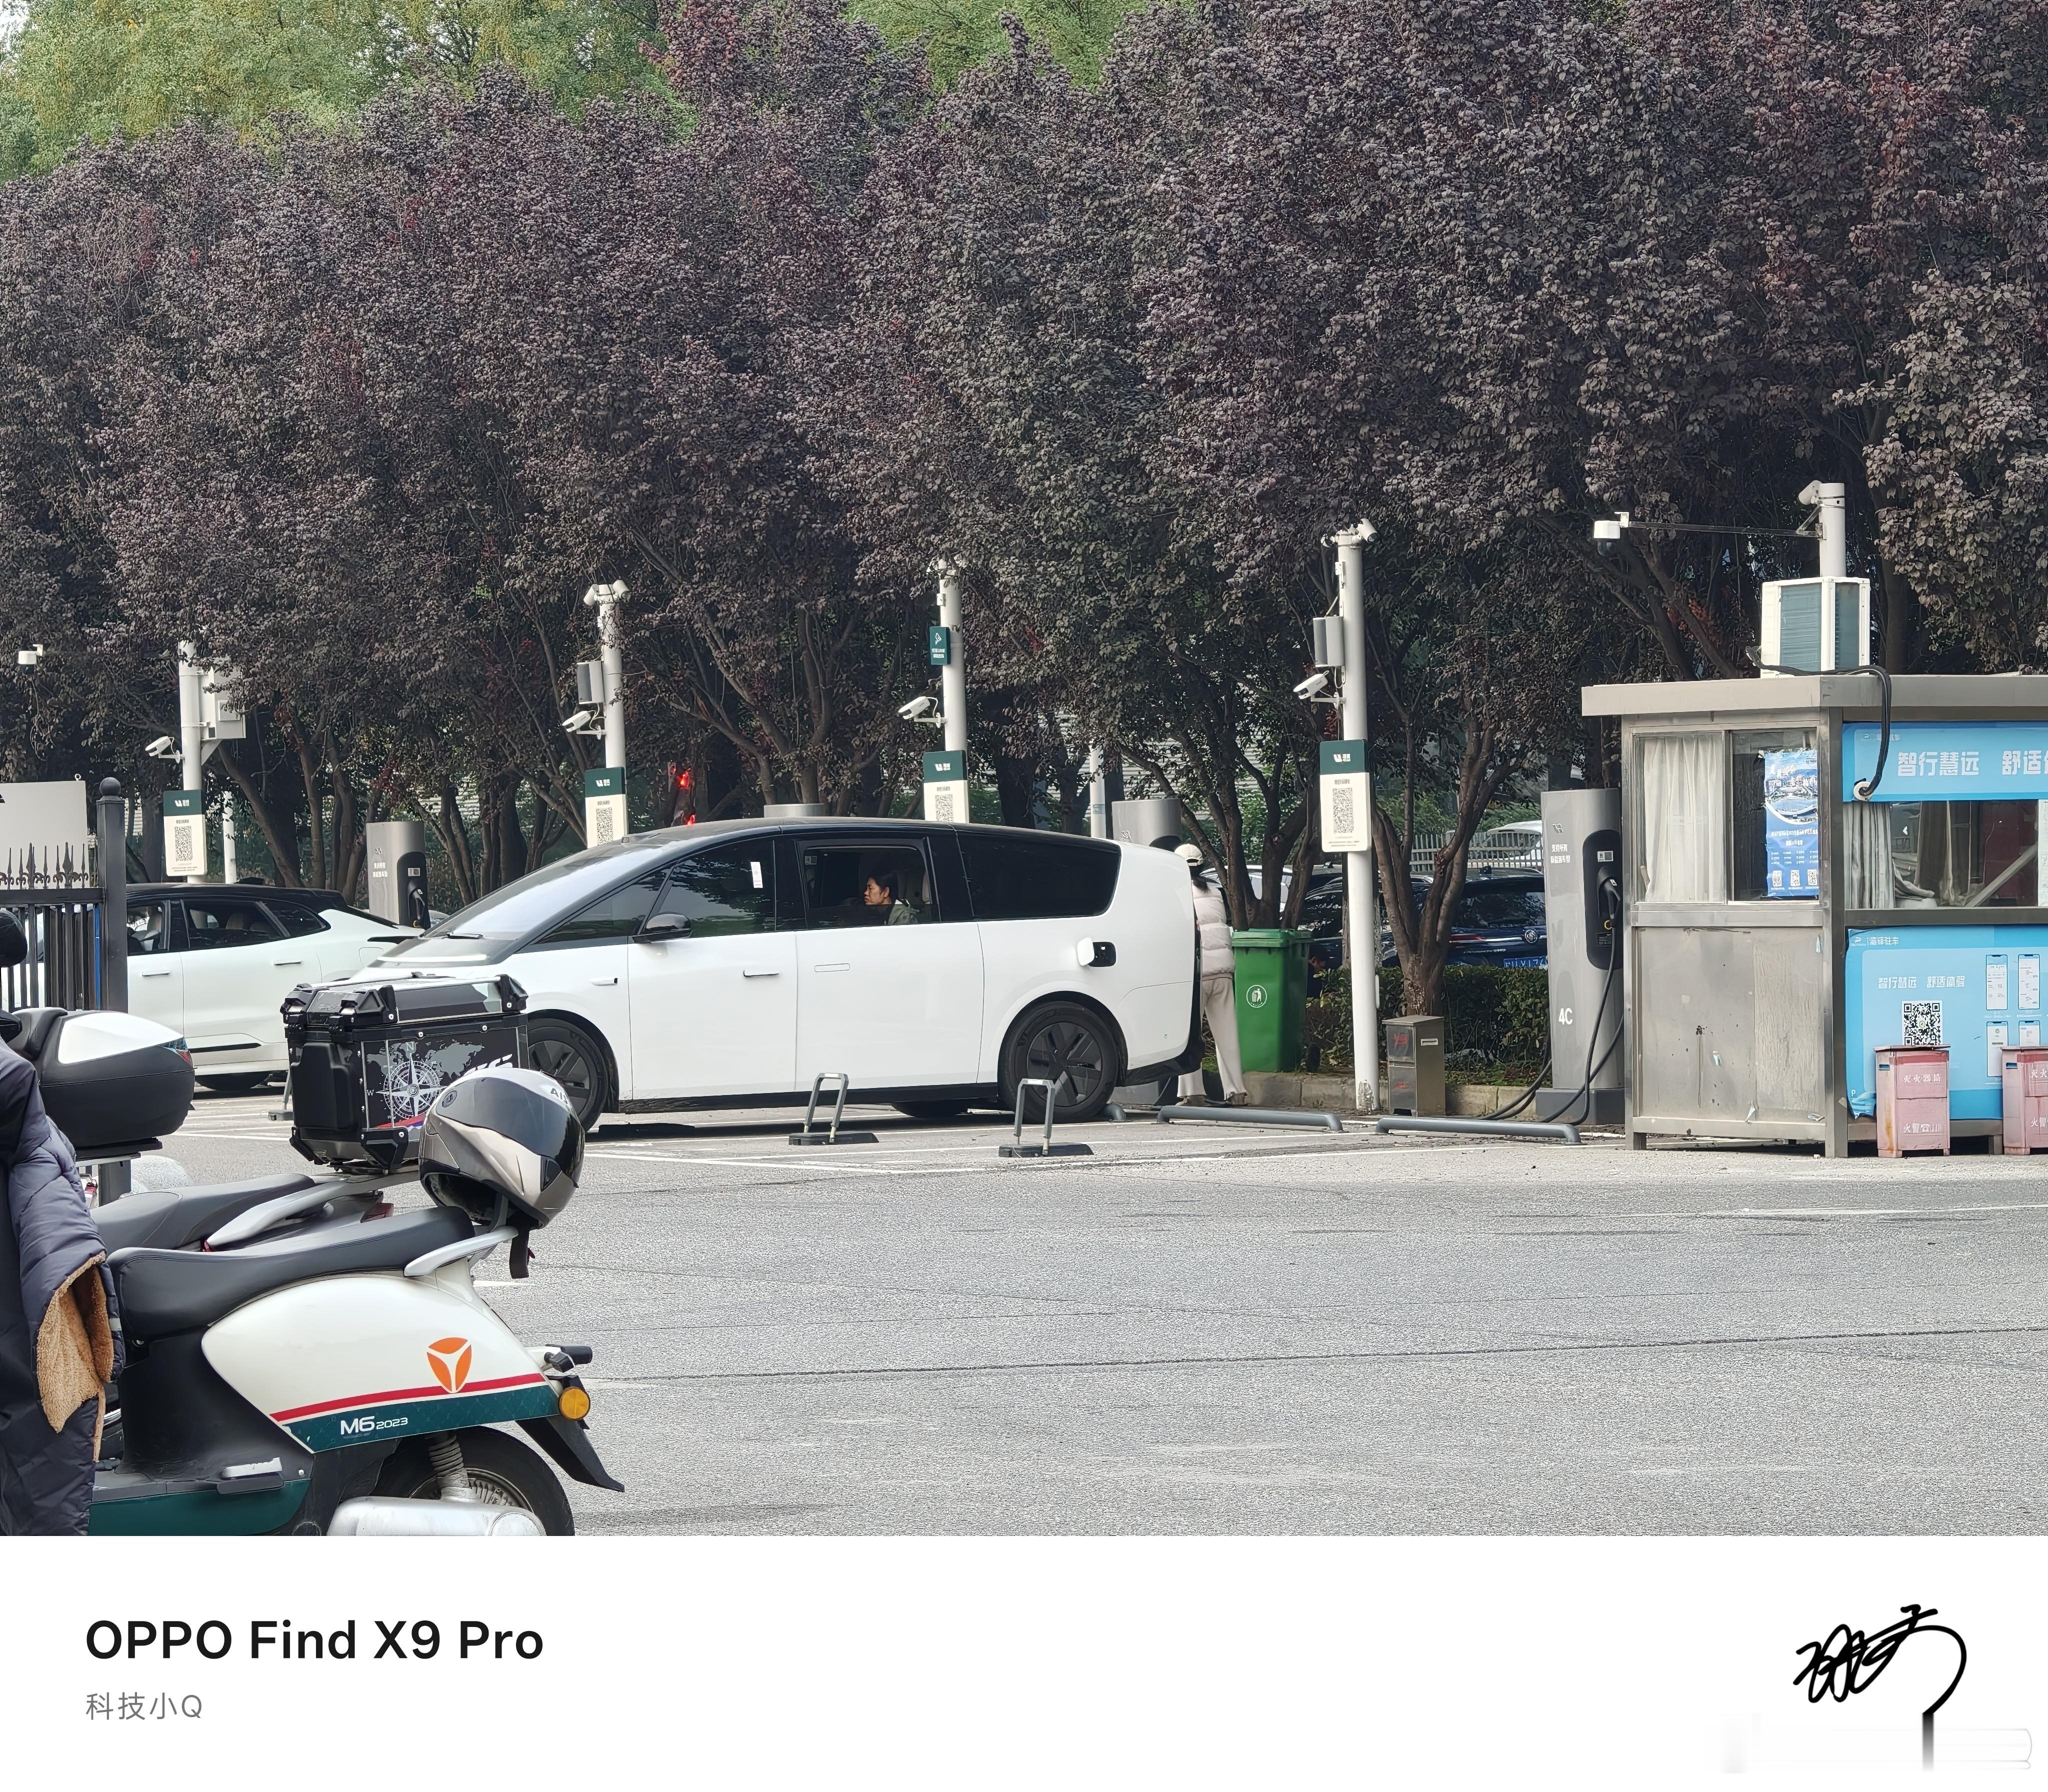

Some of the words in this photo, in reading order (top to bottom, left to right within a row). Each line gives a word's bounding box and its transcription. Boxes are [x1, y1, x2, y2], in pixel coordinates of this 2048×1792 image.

[1898, 752, 1980, 776] 智行慧远
[2002, 750, 2048, 776] 舒适
[1926, 976, 1965, 988] 舒适体验
[1558, 1008, 1573, 1025] 4C
[340, 1416, 375, 1434] M6
[376, 1417, 408, 1430] 2023
